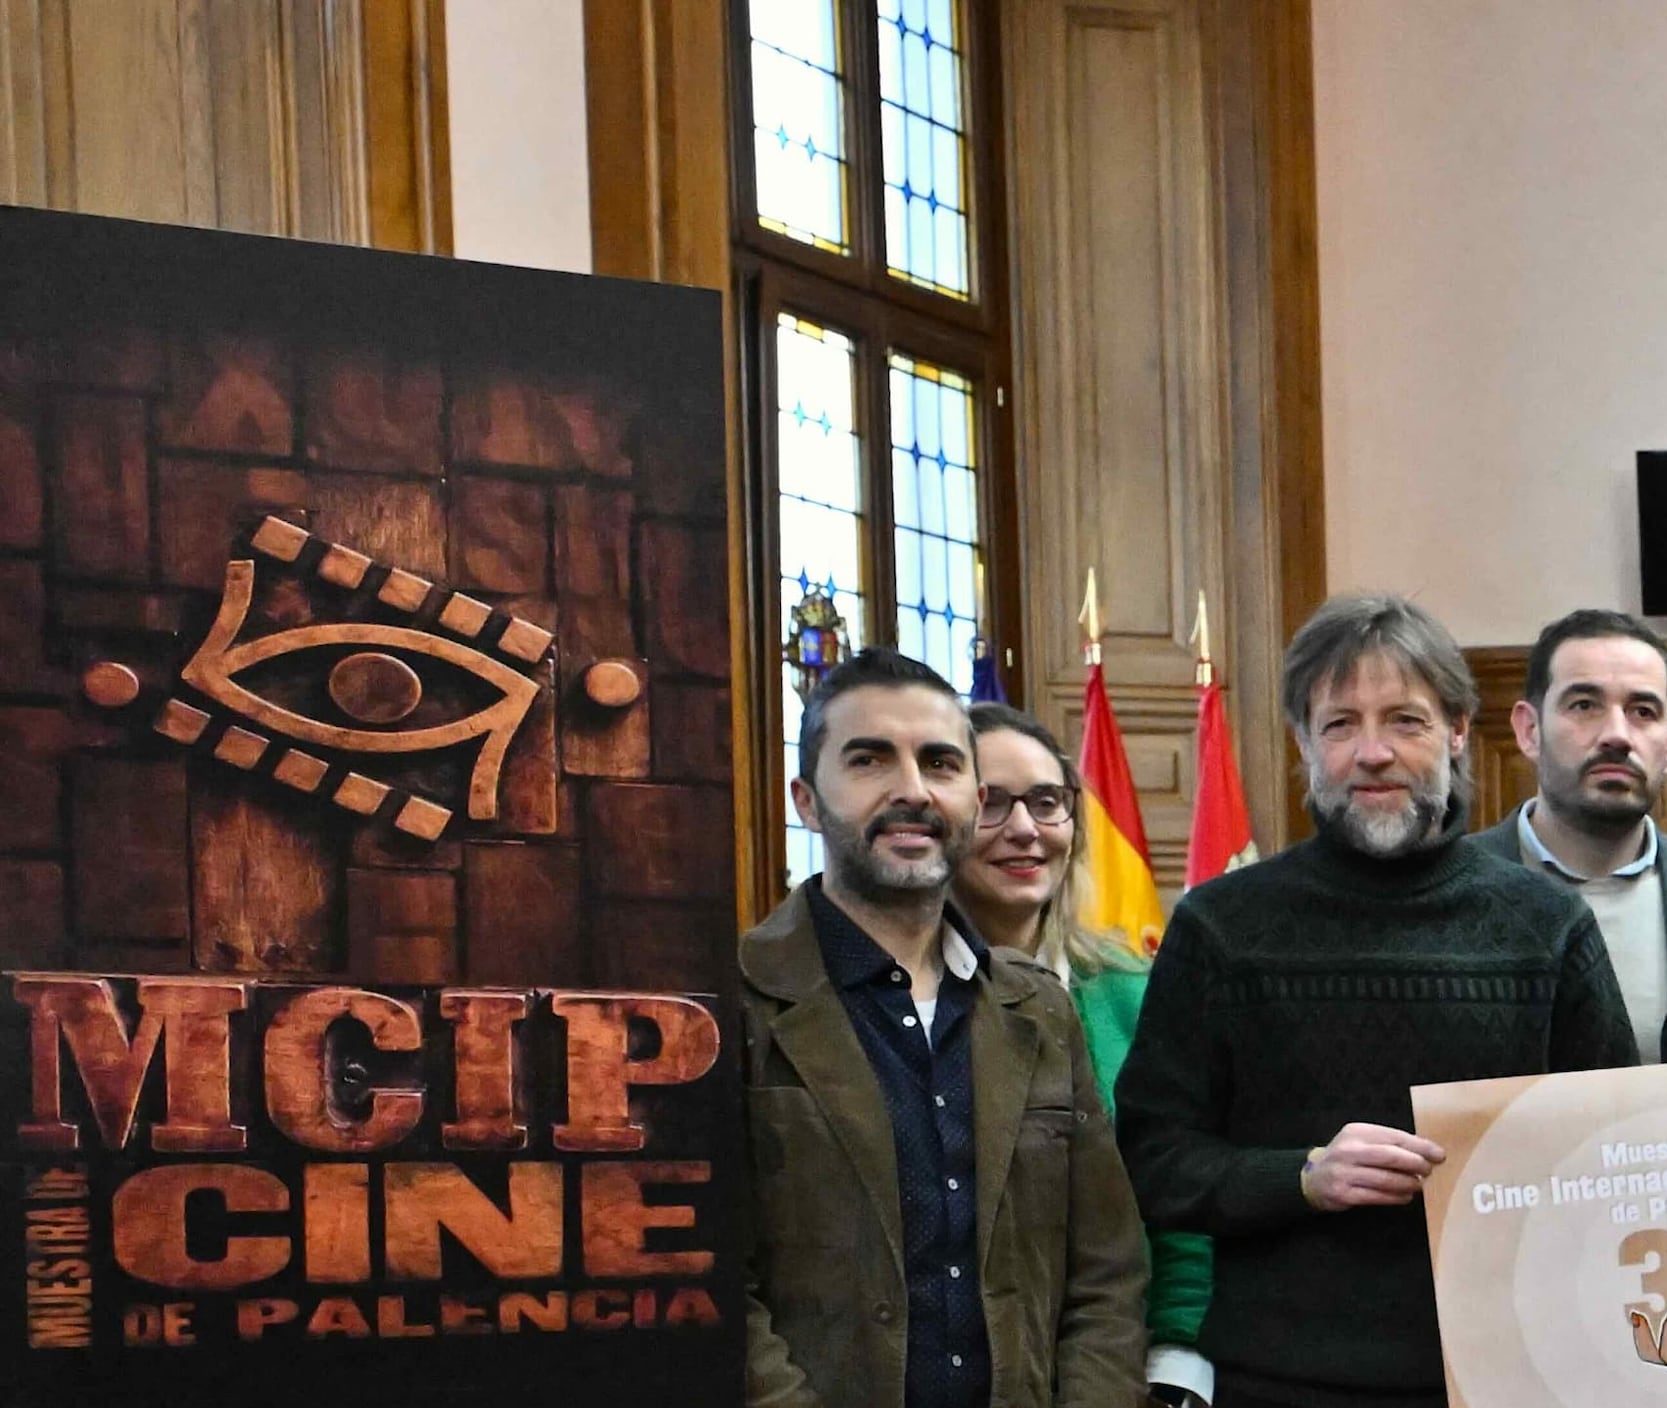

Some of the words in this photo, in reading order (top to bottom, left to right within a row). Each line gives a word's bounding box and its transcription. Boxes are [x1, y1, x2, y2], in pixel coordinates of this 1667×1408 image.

[14, 972, 721, 1151] MCIP
[112, 1162, 714, 1289] CINE
[1473, 1183, 1539, 1214] Cine
[1611, 1201, 1640, 1224] de
[25, 1207, 92, 1349] MUESTRA
[124, 1303, 196, 1345] DE
[237, 1289, 721, 1340] PALENCIA
